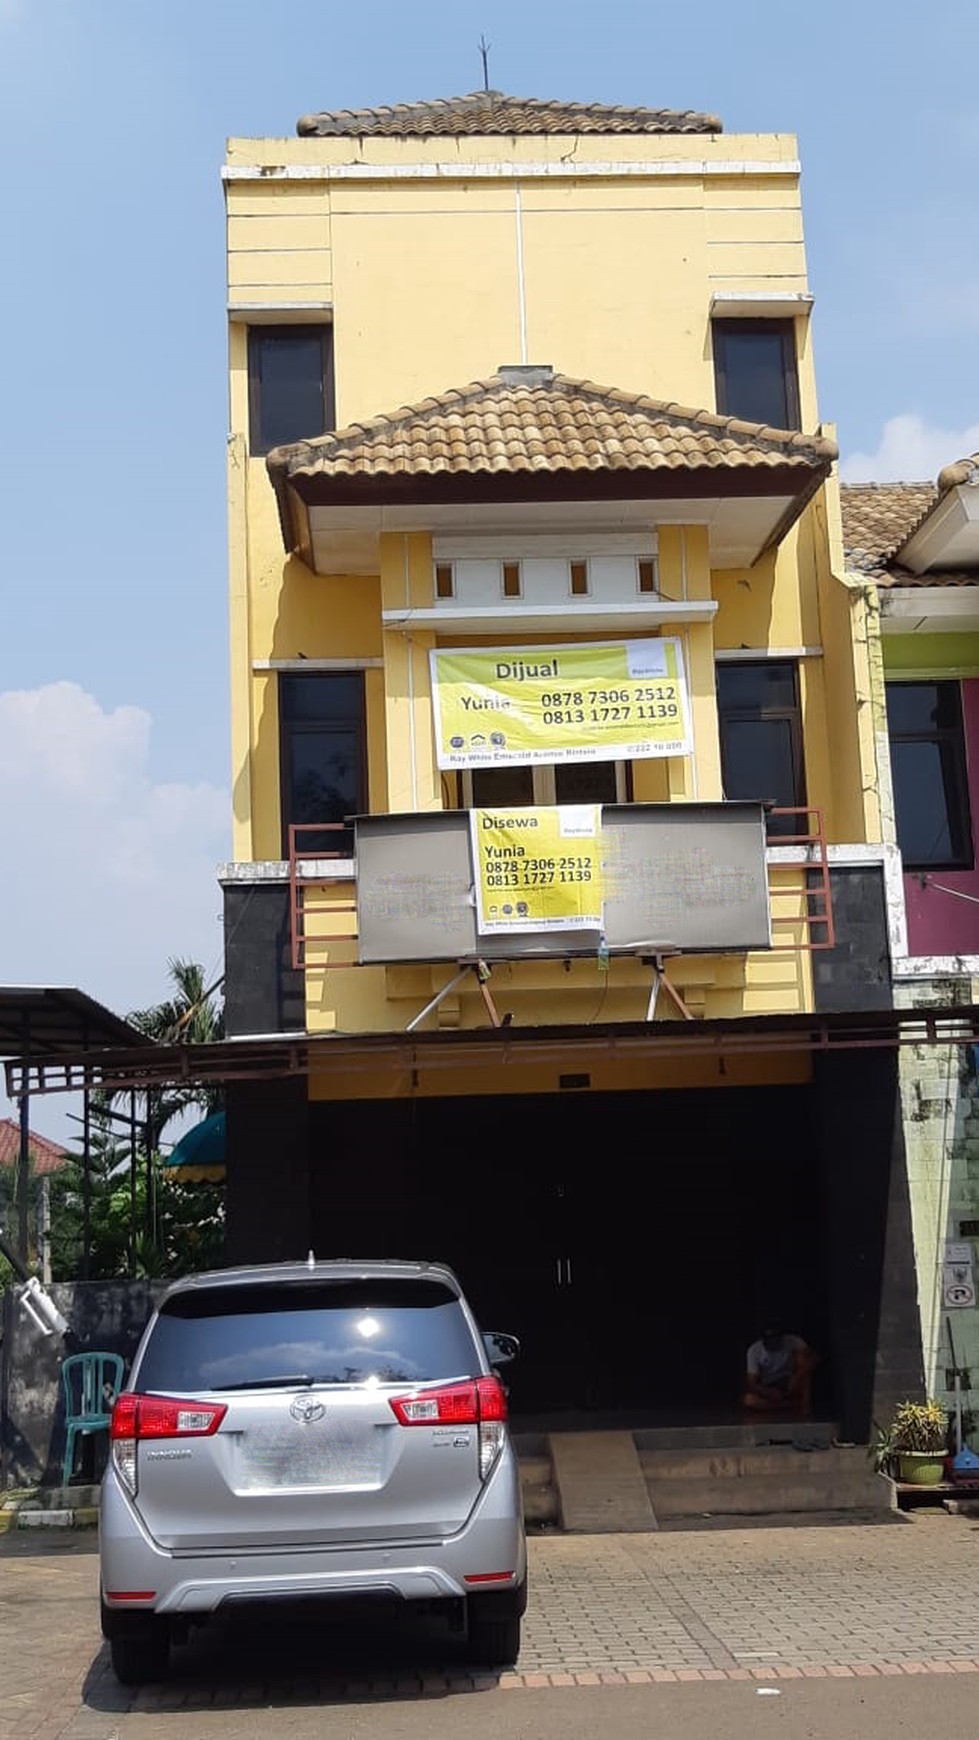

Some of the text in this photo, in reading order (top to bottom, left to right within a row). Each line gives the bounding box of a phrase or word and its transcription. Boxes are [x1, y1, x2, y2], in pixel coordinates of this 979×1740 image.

[496, 659, 559, 682] Dijual
[461, 696, 510, 711] Yunia
[541, 687, 676, 708] 0878 7306 2512
[543, 703, 678, 725] 0813 1727 1139
[482, 816, 538, 830] Disewa
[484, 844, 526, 858] Yunia
[486, 857, 592, 873] 0878 7306 2512
[487, 870, 592, 886] 0813 1727 1139
